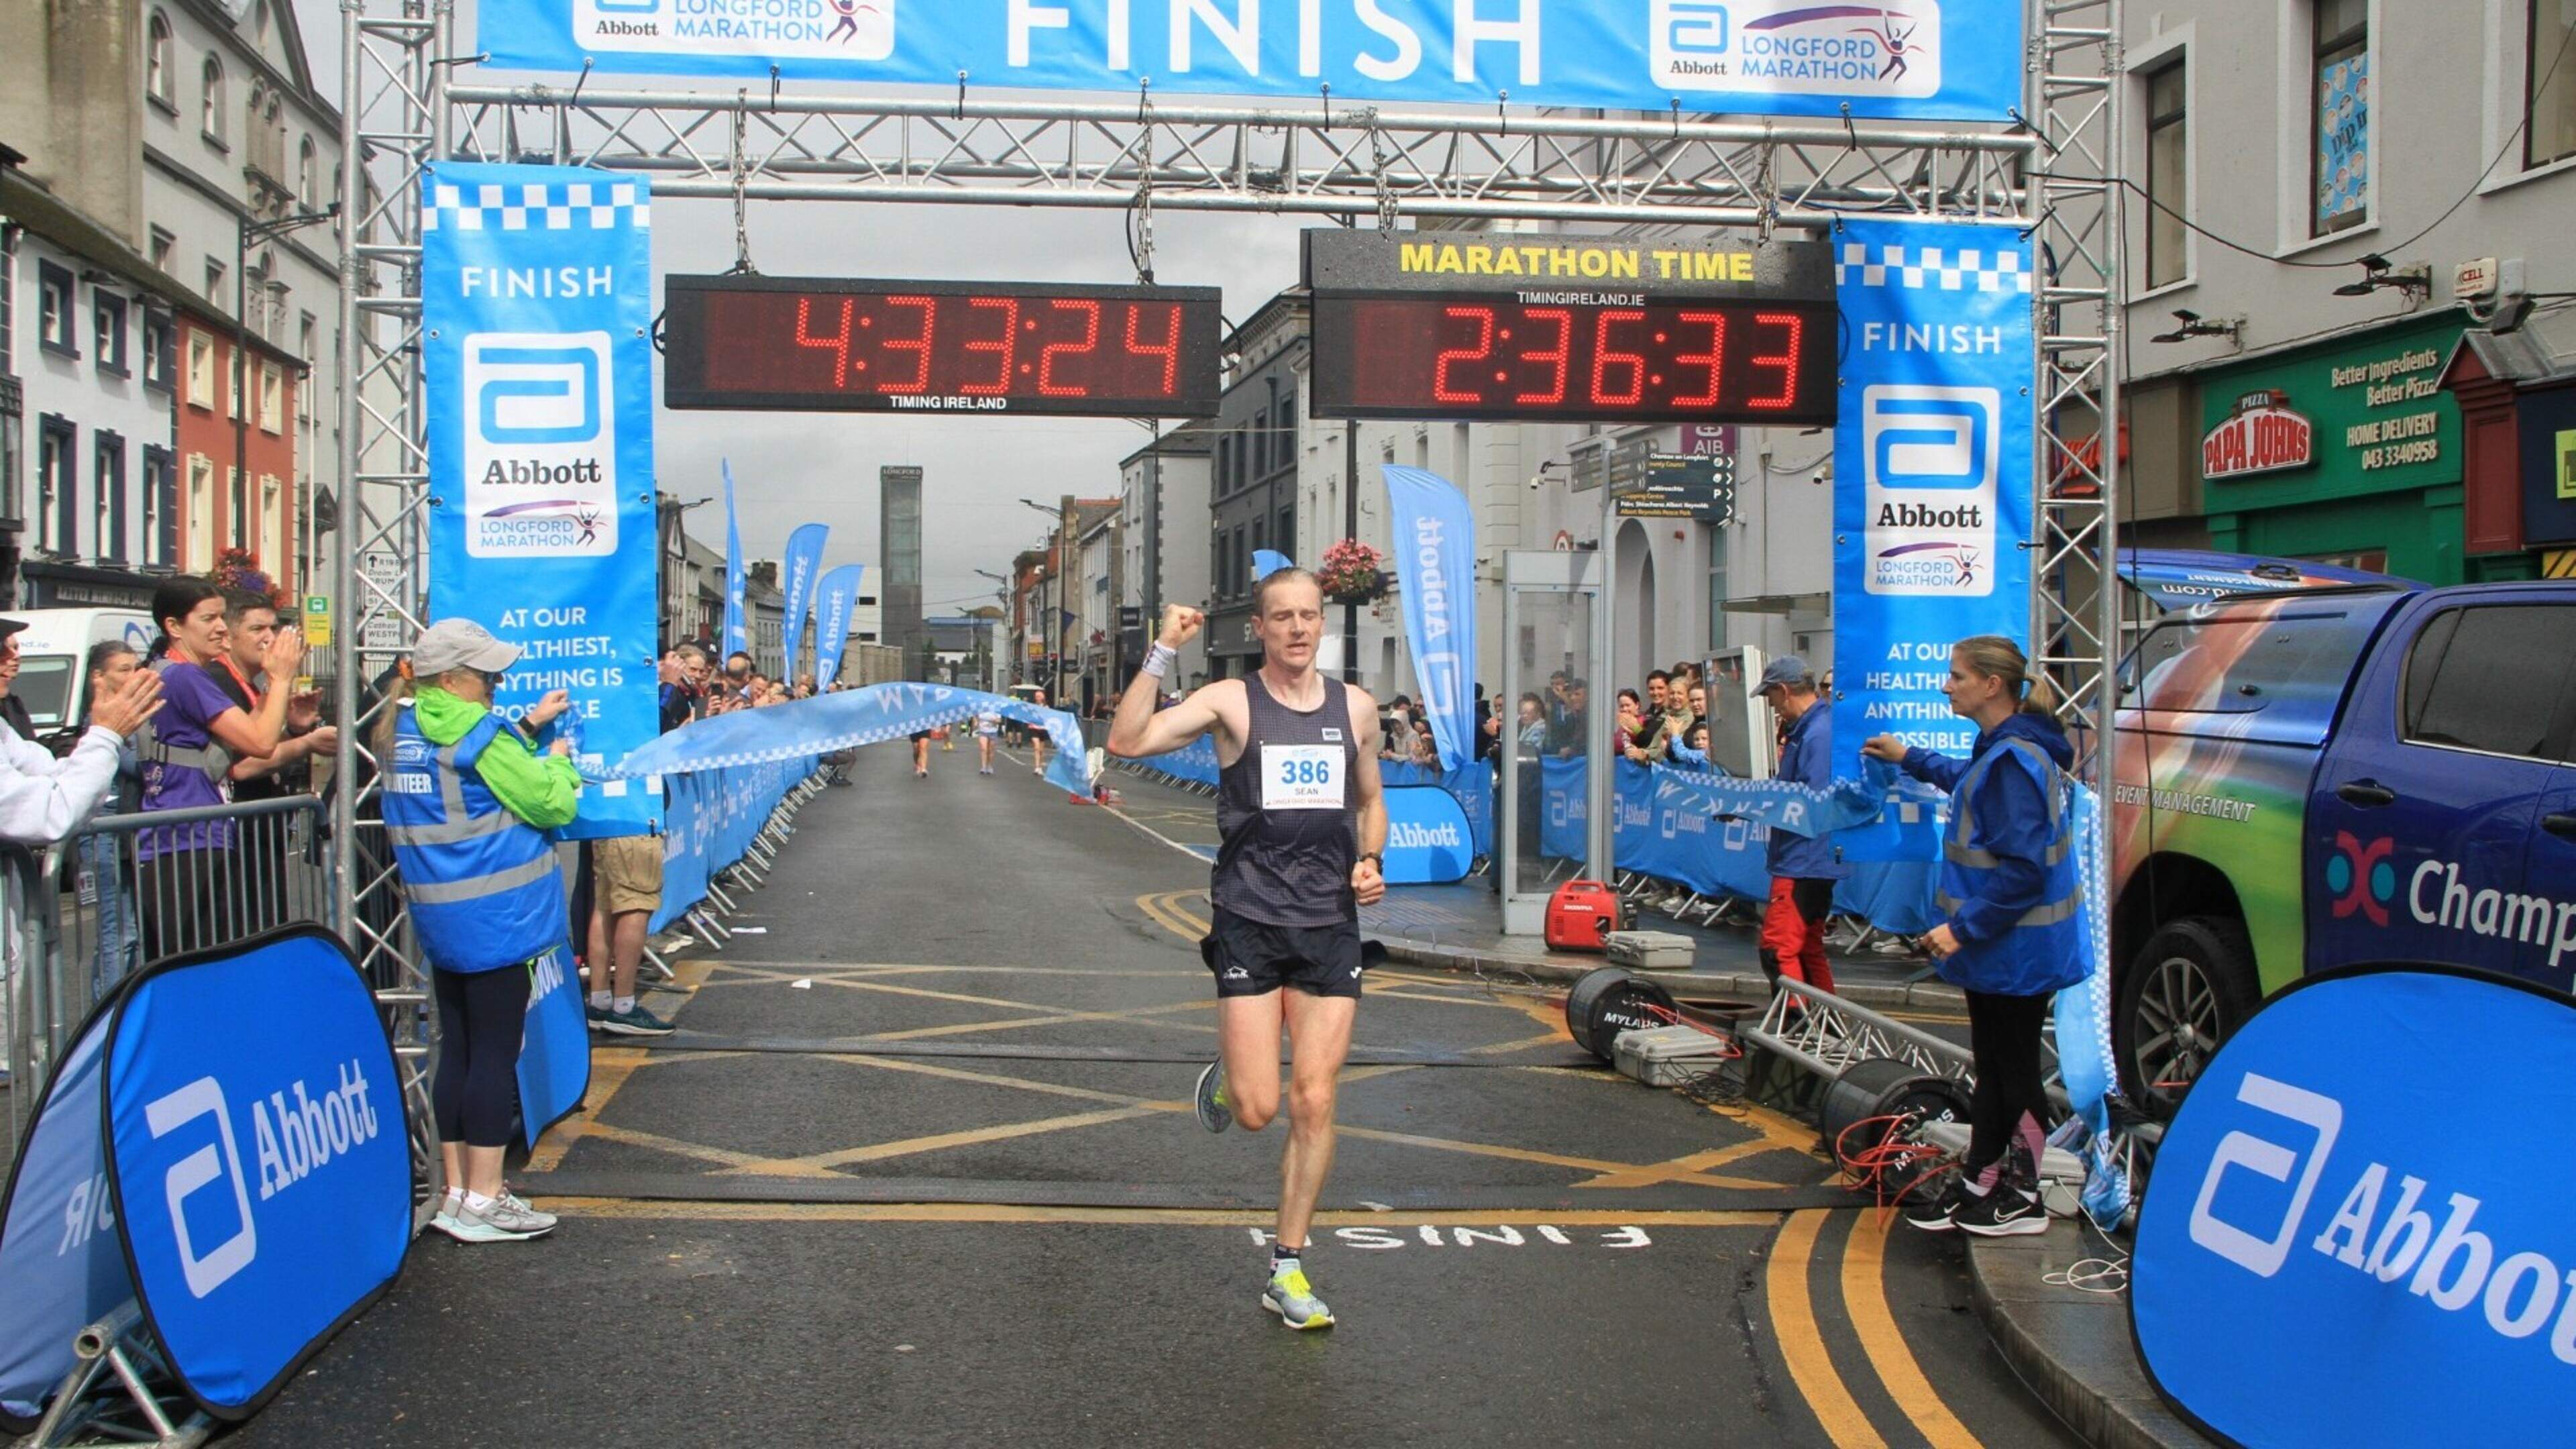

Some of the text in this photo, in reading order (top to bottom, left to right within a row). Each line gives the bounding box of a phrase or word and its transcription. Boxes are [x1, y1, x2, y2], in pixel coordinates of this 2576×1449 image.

[675, 0, 823, 19] LONGFORD
[596, 20, 659, 36] Abbott
[674, 18, 823, 41] MARATHON
[1008, 0, 1540, 86] FINISH
[1742, 36, 1876, 59] LONGFORD
[1669, 60, 1727, 76] Abbott
[1741, 60, 1876, 80] MARATHON
[1401, 244, 1754, 281] MARATHON TIME
[461, 266, 612, 298] FINISH
[1517, 291, 1645, 307] TIMINGIRELAND.IE
[797, 297, 1181, 396] 4:33:24
[1863, 323, 2000, 354] FINISH
[1434, 308, 1802, 407] 2:36:33
[2331, 349, 2438, 388] Better Ingredients
[890, 395, 1007, 411] TIMING IRELAND
[2242, 393, 2269, 409] PIZZA
[2366, 378, 2438, 407] Better Pizza
[2347, 412, 2437, 447] HOME DELIVERY
[1693, 439, 1725, 454] AIB
[2205, 420, 2247, 474] PAPA
[2361, 439, 2438, 470] 043 3340958
[482, 458, 601, 485] Abbott
[1713, 489, 1722, 499] P
[1877, 503, 1982, 527] Abbott
[481, 521, 574, 534] LONGFORD
[481, 535, 574, 547] MARATHON
[1876, 561, 1955, 574] LONGFORD
[1876, 574, 1955, 587] MARATHON
[500, 607, 586, 628] AT OUR
[824, 589, 845, 653] Abbott
[519, 637, 616, 659] LTHIEST,
[1887, 643, 1953, 661] AT OU
[496, 668, 623, 692] NYTHING IS
[1865, 702, 1956, 720] ANYTHIN
[1281, 760, 1329, 784] 386
[1295, 787, 1318, 795] SEAN
[2115, 785, 2149, 806] EVENT
[2152, 790, 2255, 822] MANAGEMENT
[1389, 822, 1460, 849] Abbott
[1604, 1012, 1660, 1028] MYLAPS
[252, 1058, 378, 1202] Abbott
